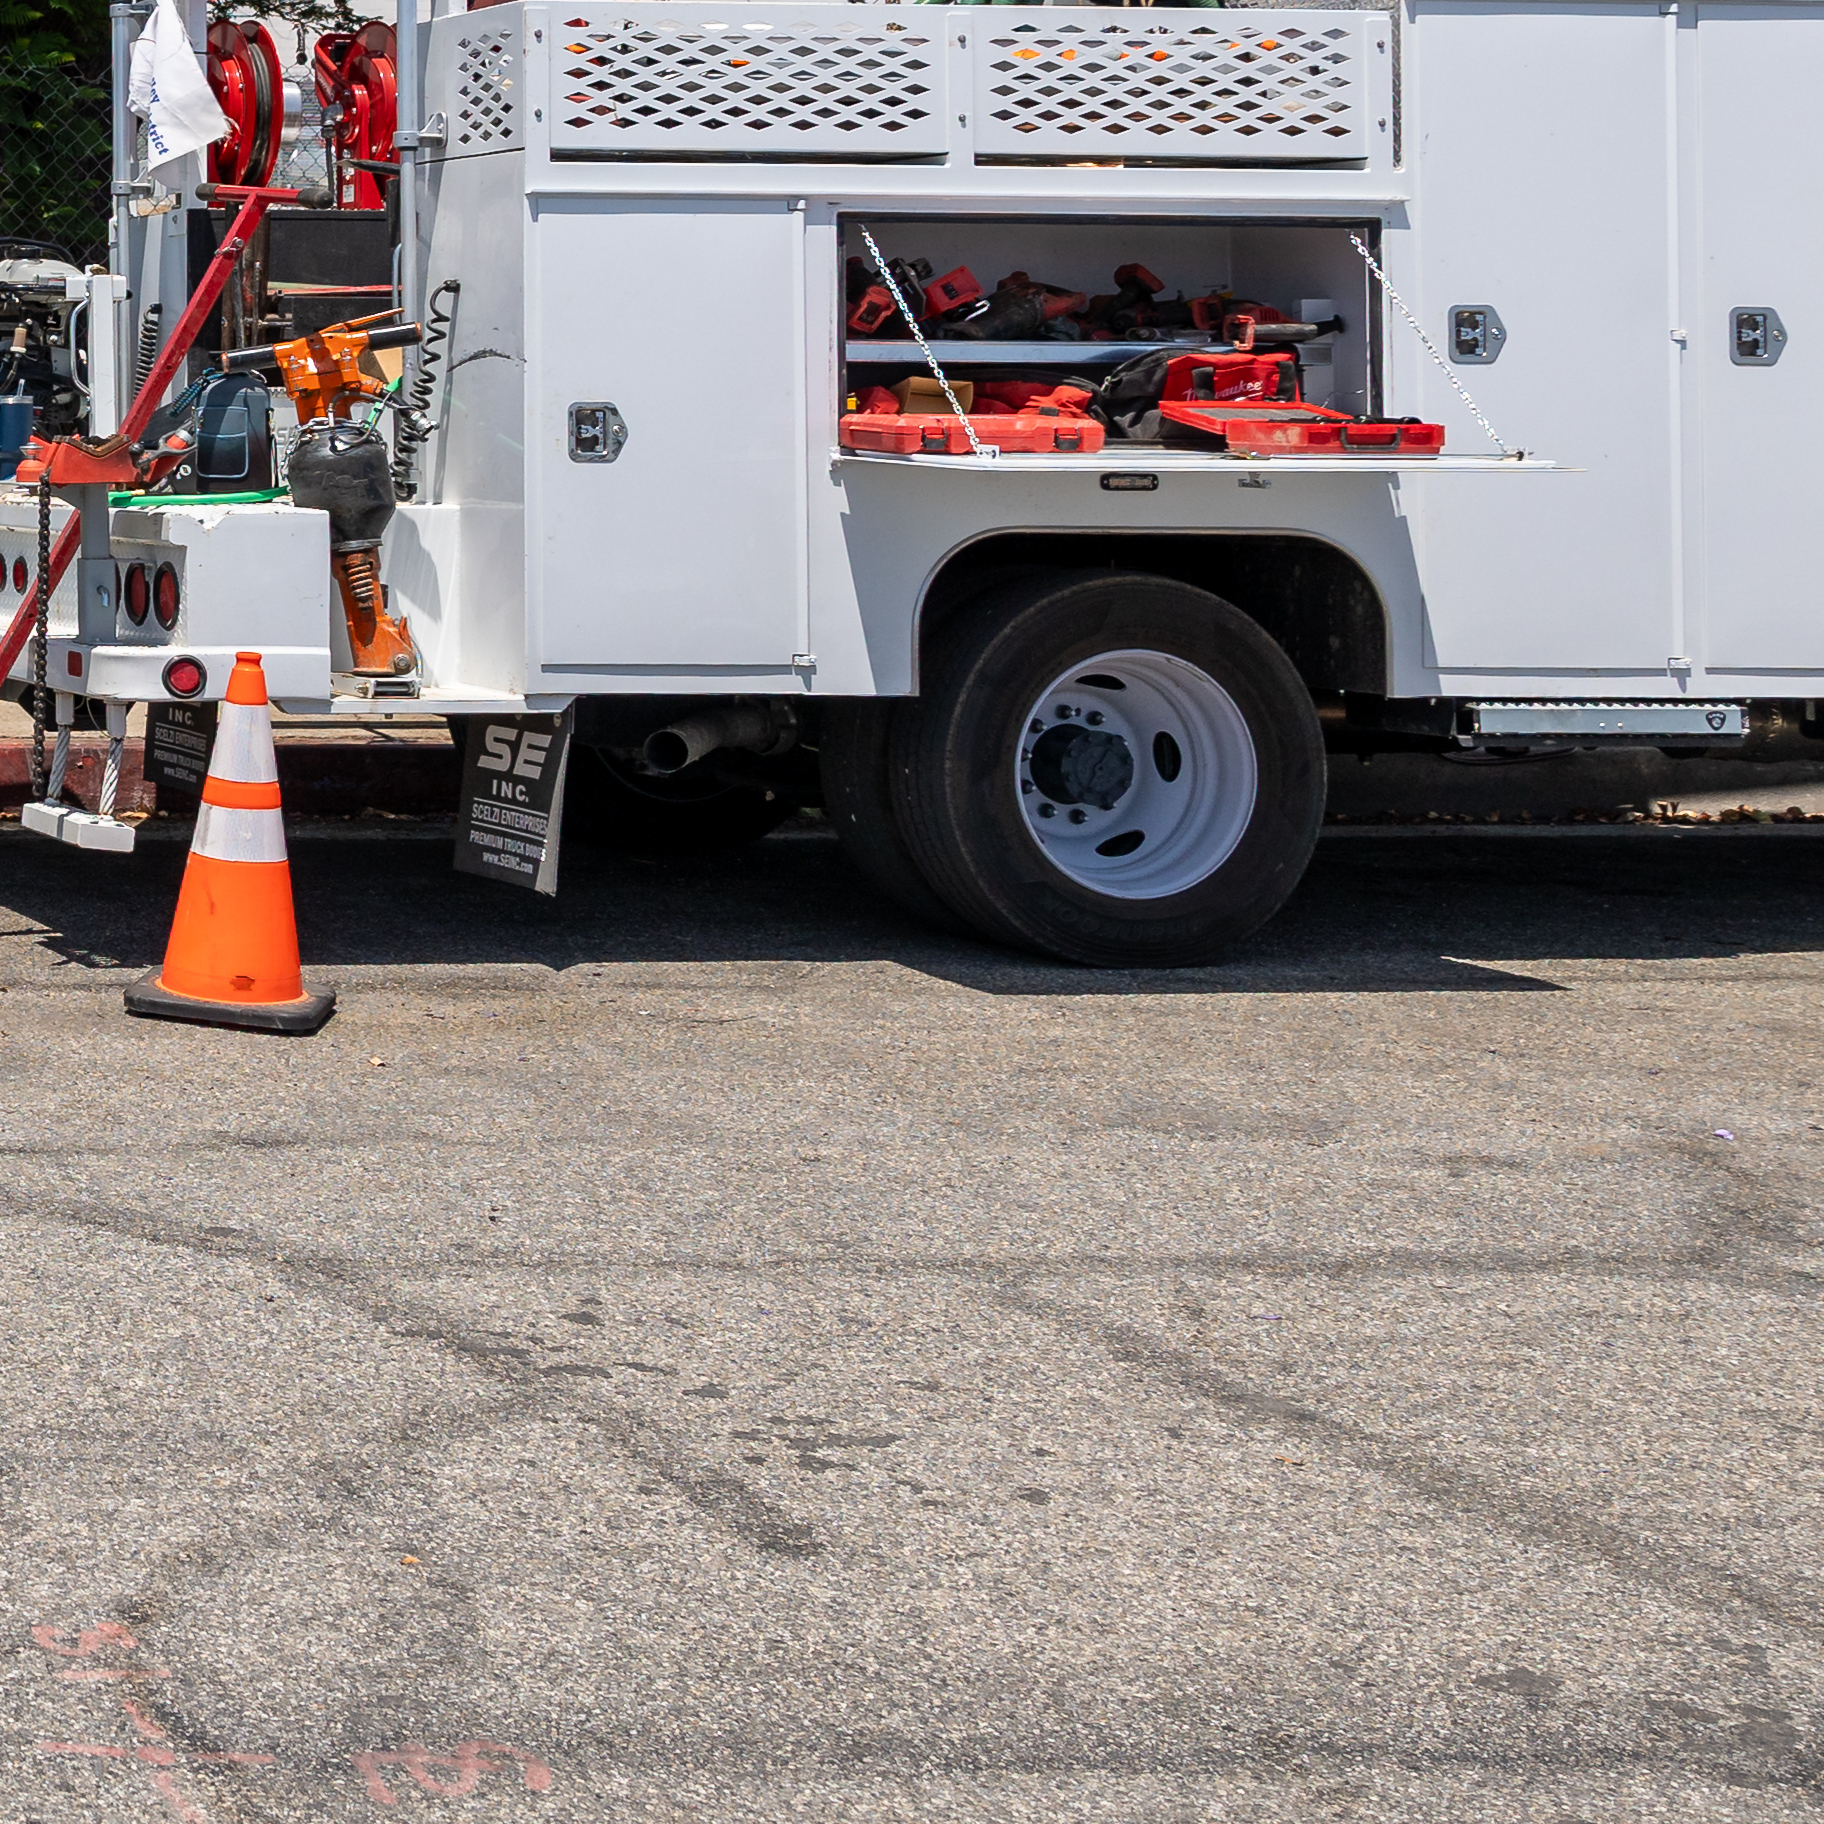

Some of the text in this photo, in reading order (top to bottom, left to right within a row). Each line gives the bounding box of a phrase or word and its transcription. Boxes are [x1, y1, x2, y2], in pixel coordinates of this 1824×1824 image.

[477, 725, 552, 780] SE
[492, 779, 529, 803] INC.
[472, 803, 548, 834] SCELZI ENTERPRISES
[469, 830, 503, 849] PREMIUM
[504, 838, 525, 856] TRUCK
